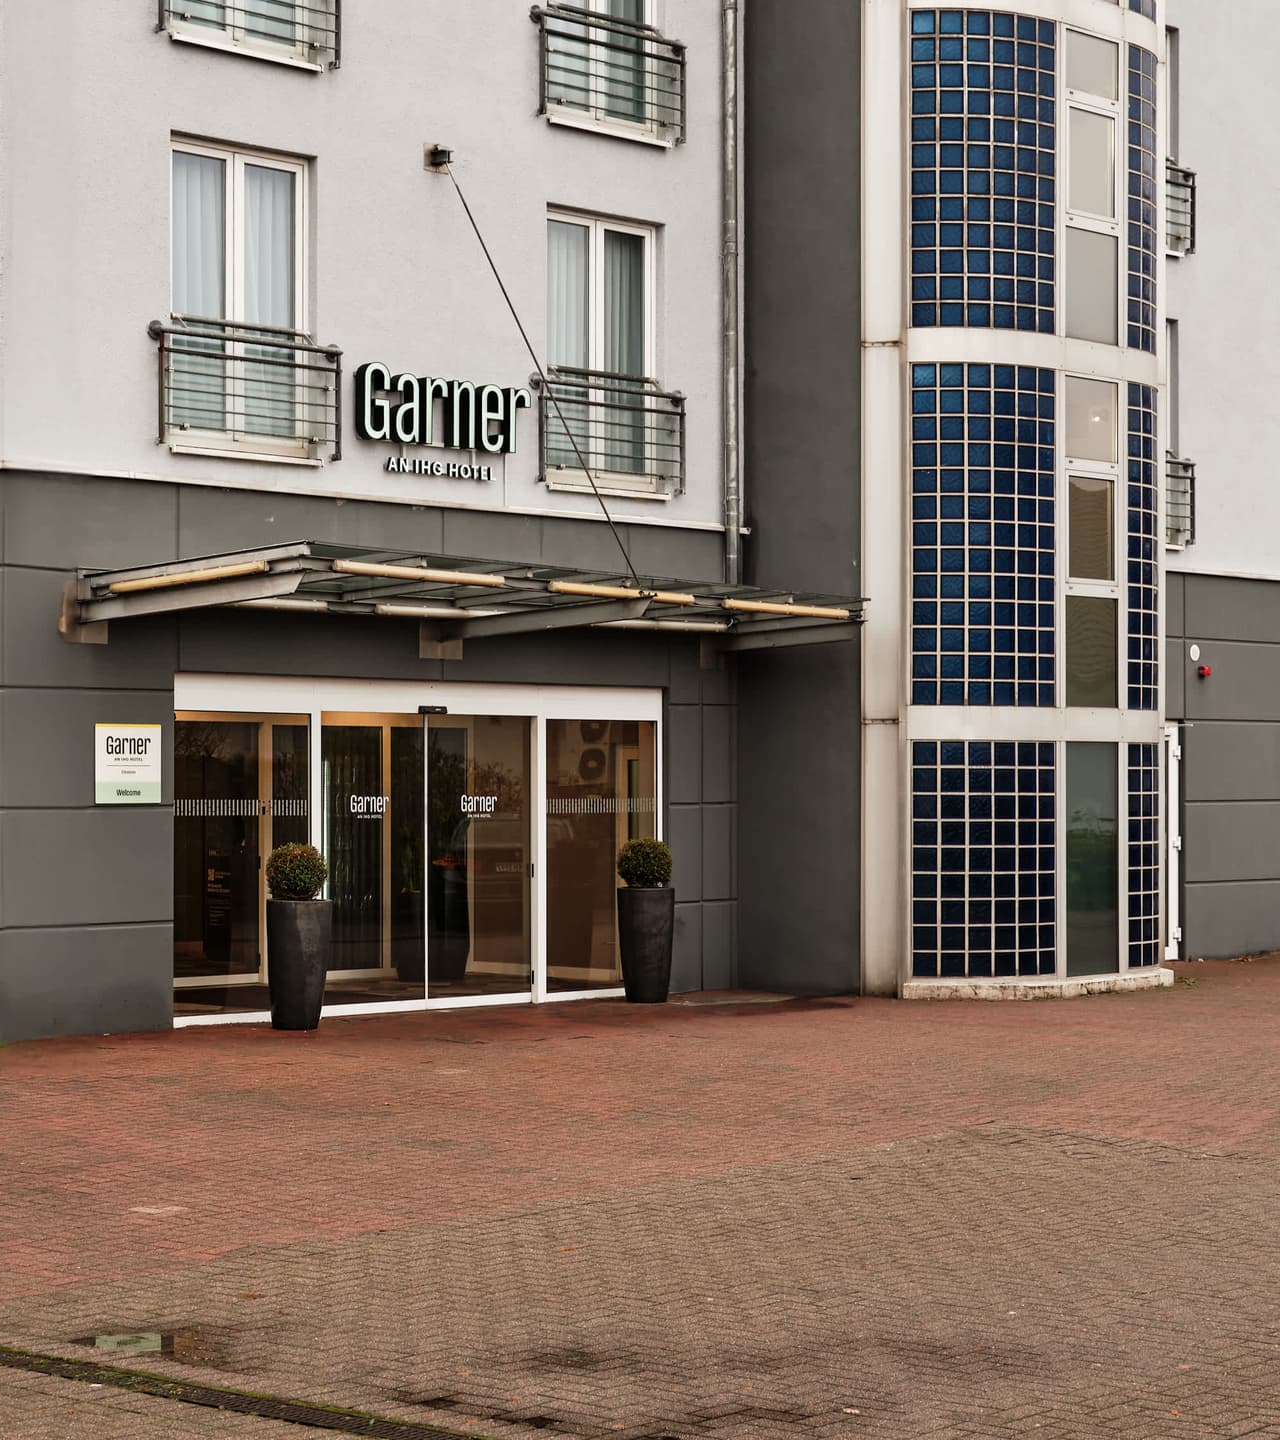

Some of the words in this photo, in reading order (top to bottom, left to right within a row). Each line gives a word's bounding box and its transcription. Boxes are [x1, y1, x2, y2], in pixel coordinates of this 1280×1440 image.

[356, 362, 532, 454] Garner
[386, 456, 409, 473] AN
[413, 459, 443, 476] IHG
[448, 463, 497, 481] HOTEL
[106, 735, 151, 755] Garner
[116, 788, 141, 797] Welcome
[350, 794, 390, 813] Garner
[460, 794, 498, 812] Garner
